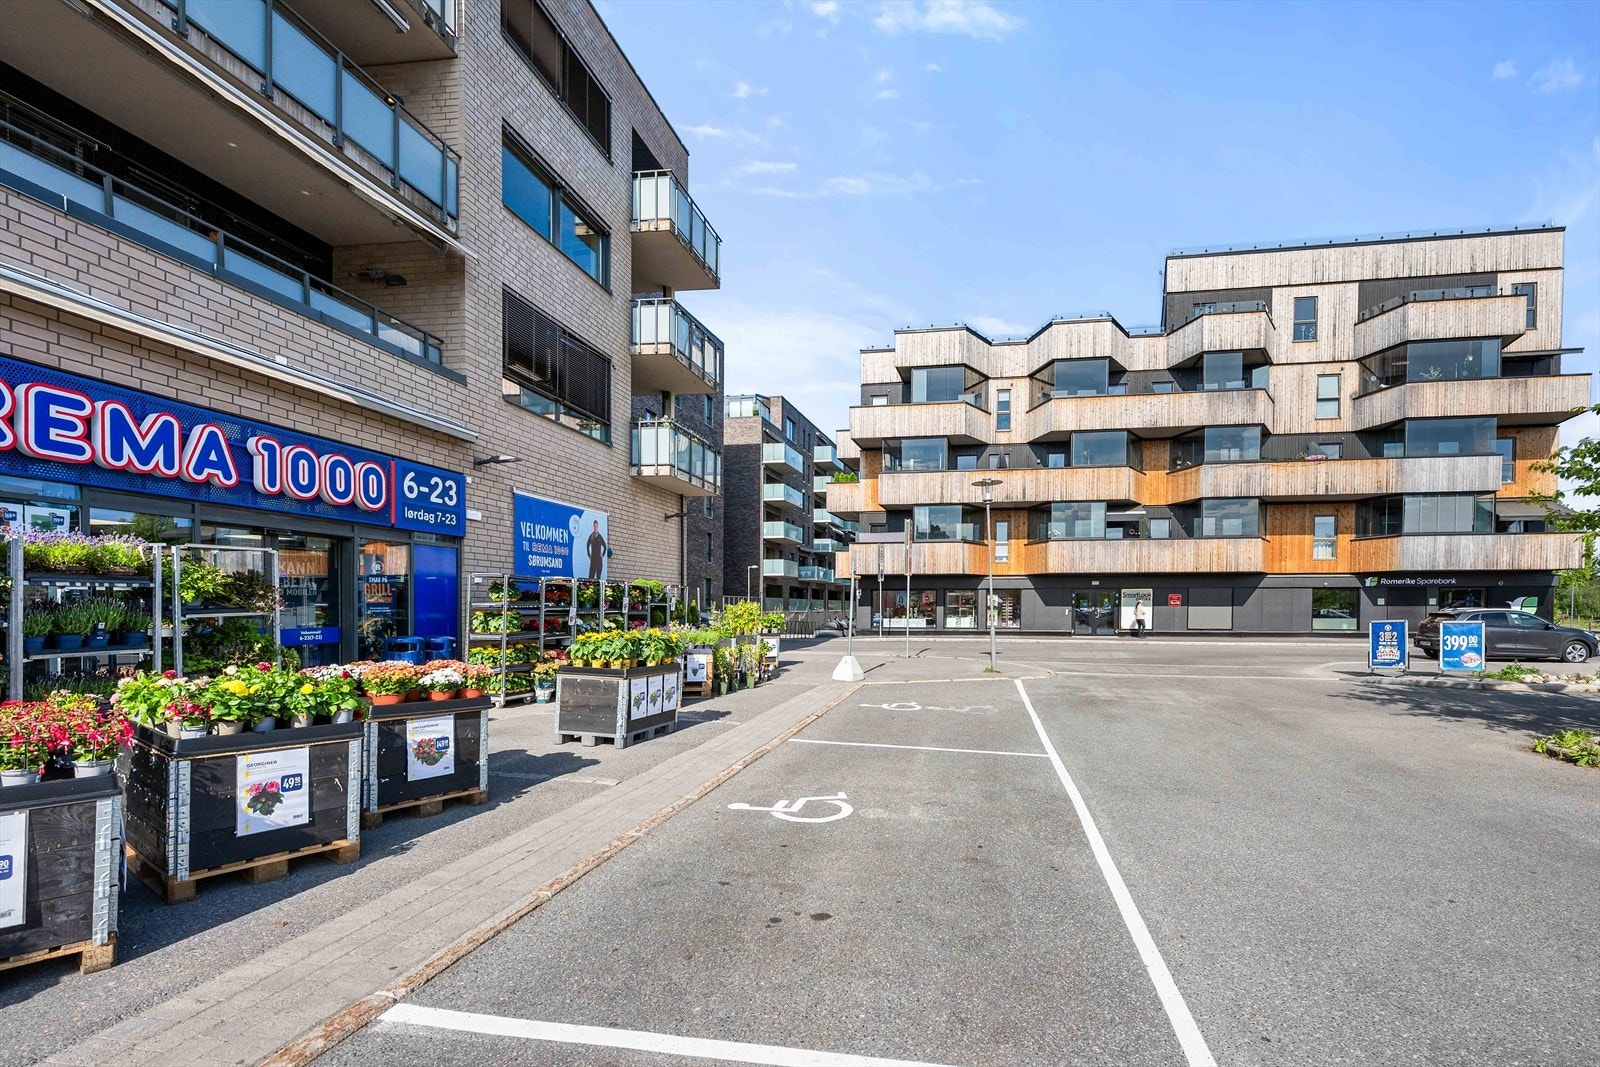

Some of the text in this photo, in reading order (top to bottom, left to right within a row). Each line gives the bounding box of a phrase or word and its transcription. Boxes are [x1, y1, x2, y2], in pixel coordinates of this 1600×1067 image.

[0, 378, 386, 511] EMA 1000
[403, 471, 457, 506] 6-23
[404, 506, 456, 525] lørdag 7-23
[520, 521, 569, 544] VELKOMMEN
[522, 540, 530, 551] TIL
[531, 541, 553, 554] REMA
[528, 554, 563, 569] SØRUMSAND
[381, 575, 388, 583] PÅ
[1380, 577, 1456, 586] Romerike Sparebank
[364, 583, 396, 595] GRILL-
[1378, 632, 1385, 642] 3
[1392, 632, 1398, 642] 2
[1443, 635, 1468, 651] 399
[246, 760, 278, 768] GEORGINER
[282, 777, 295, 789] 49
